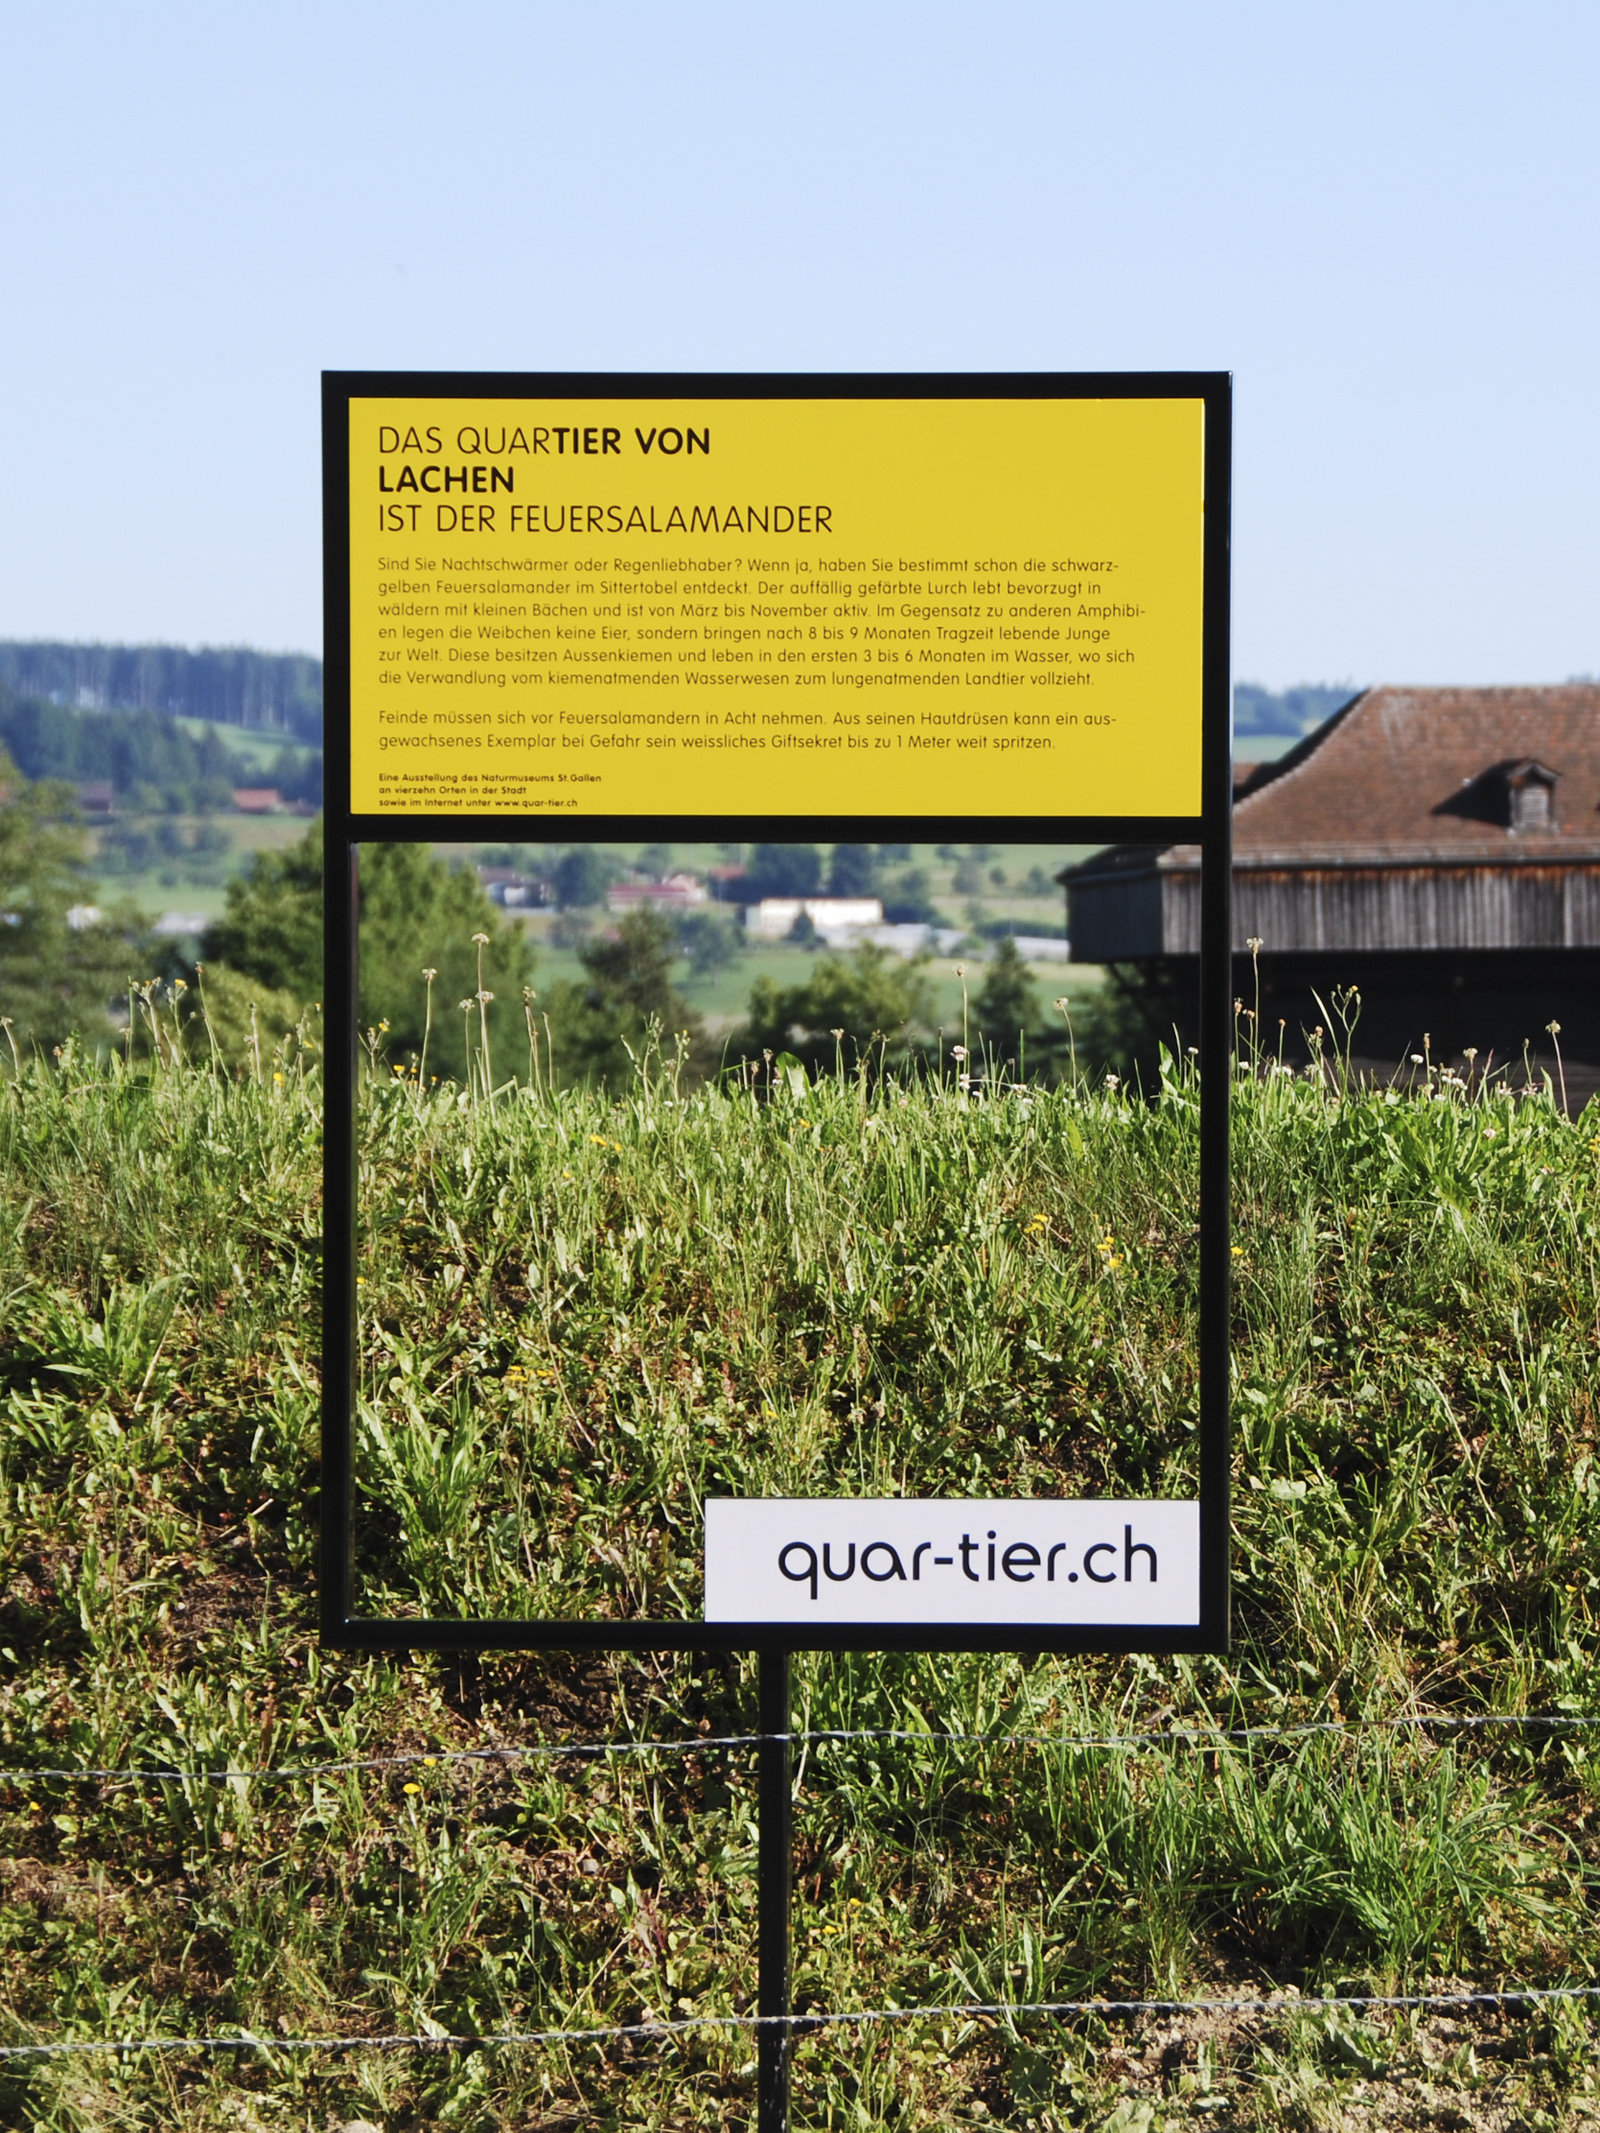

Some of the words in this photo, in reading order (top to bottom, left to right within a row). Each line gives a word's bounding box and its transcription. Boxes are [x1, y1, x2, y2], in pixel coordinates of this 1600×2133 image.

[379, 426, 443, 454] DAS
[457, 426, 621, 455] QUARTIER
[634, 427, 710, 455] VON
[379, 465, 514, 493] LACHEN
[379, 504, 422, 532] IST
[437, 504, 495, 532] DER
[511, 505, 832, 533] FEUERSALAMANDER
[377, 557, 410, 571] Sind
[414, 558, 437, 572] Sie
[441, 558, 569, 572] Nachtschwärmer
[573, 558, 609, 572] oder
[613, 558, 743, 576] Regenliebhaber?
[746, 559, 790, 573] Wenn
[795, 559, 813, 576] ja,
[818, 558, 867, 573] haben
[871, 559, 894, 573] Sie
[898, 558, 969, 573] bestimmt
[973, 558, 1018, 573] schon
[1022, 558, 1047, 573] die
[1050, 558, 1119, 573] schwarz-
[378, 580, 431, 597] gelben
[436, 580, 571, 595] Feuersalamander
[576, 581, 595, 594] im
[599, 580, 678, 595] Sittertobel
[682, 580, 752, 595] entdeckt.
[757, 581, 785, 595] Der
[789, 580, 853, 599] auffällig
[857, 580, 923, 599] gefärbte
[927, 580, 968, 596] Lurch
[972, 580, 1002, 595] lebt
[1006, 580, 1083, 599] bevorzugt
[1087, 581, 1102, 595] in
[377, 602, 440, 617] wäldern
[444, 603, 468, 617] mit
[472, 603, 527, 617] kleinen
[531, 603, 588, 617] Bächen
[592, 603, 622, 617] und
[626, 604, 644, 617] ist
[647, 607, 675, 617] von
[679, 604, 719, 618] März
[723, 603, 746, 618] bis
[750, 603, 829, 618] November
[832, 604, 872, 618] aktiv.
[876, 604, 896, 617] Im
[899, 604, 982, 621] Gegensatz
[986, 607, 1004, 618] zu
[1008, 604, 1072, 618] anderen
[1076, 603, 1146, 621] Amphibi-
[378, 628, 398, 639] en
[402, 625, 445, 643] legen
[449, 625, 473, 640] die
[477, 625, 551, 640] Weibchen
[556, 625, 597, 640] keine
[599, 626, 631, 642] Eier,
[636, 626, 699, 640] sondern
[703, 626, 762, 644] bringen
[766, 626, 803, 640] nach
[807, 626, 818, 641] 8
[822, 626, 845, 641] bis
[849, 627, 859, 640] 9
[863, 627, 931, 641] Monaten
[935, 627, 994, 644] Tragzeit
[998, 626, 1061, 641] lebende
[1064, 627, 1111, 644] Junge
[378, 651, 402, 662] zur
[406, 648, 443, 662] Welt.
[447, 648, 491, 662] Diese
[494, 648, 558, 663] besitzen
[562, 648, 673, 663] Aussenkiemen
[677, 649, 707, 663] und
[711, 649, 754, 663] leben
[758, 650, 773, 663] in
[776, 648, 807, 663] den
[810, 650, 858, 663] ersten
[862, 649, 873, 663] 3
[877, 649, 900, 663] bis
[904, 650, 914, 663] 6
[918, 649, 986, 663] Monaten
[990, 650, 1010, 663] im
[1013, 649, 1073, 665] Wasser,
[1077, 652, 1102, 664] wo
[1105, 649, 1135, 664] sich
[378, 670, 402, 685] die
[405, 670, 507, 689] Verwandlung
[510, 674, 543, 685] vom
[547, 671, 680, 685] kiemenatmenden
[684, 672, 790, 686] Wasserwesen
[794, 675, 827, 686] zum
[831, 671, 961, 689] lungenatmenden
[965, 671, 1026, 686] Landtier
[1029, 671, 1095, 686] vollzieht.
[378, 710, 429, 725] Feinde
[432, 711, 492, 725] müssen
[496, 710, 527, 725] sich
[530, 714, 555, 725] vor
[559, 711, 701, 725] Feuersalamandern
[705, 712, 719, 725] in
[723, 711, 757, 725] Acht
[761, 712, 828, 726] nehmen.
[832, 712, 862, 726] Aus
[865, 712, 916, 726] seinen
[920, 712, 1009, 726] Hautdrüsen
[1013, 712, 1051, 726] kann
[1055, 712, 1079, 726] ein
[1083, 715, 1117, 726] aus-
[378, 733, 483, 751] gewachsenes
[487, 734, 557, 751] Exemplar
[561, 734, 585, 748] bei
[589, 734, 642, 748] Gefahr
[645, 735, 677, 749] sein
[680, 734, 767, 749] weissliches
[770, 734, 843, 749] Giftsekret
[847, 734, 870, 749] bis
[873, 738, 892, 749] zu
[896, 735, 902, 749] 1
[907, 735, 952, 749] Meter
[955, 735, 988, 749] weit
[992, 735, 1056, 752] spritzen.
[378, 773, 400, 782] Eine
[401, 774, 459, 785] Ausstellung
[460, 774, 479, 782] des
[480, 774, 555, 783] Naturmuseums
[393, 786, 437, 795] vierzehn
[438, 786, 467, 795] Orten
[469, 786, 479, 795] in
[481, 787, 499, 795] der
[500, 786, 527, 795] Stadt
[378, 798, 407, 807] sowie
[409, 799, 422, 807] im
[424, 799, 463, 807] Internet
[494, 799, 579, 809] www.quar-tier.ch
[778, 1525, 1157, 1600] quar-tier.ch
